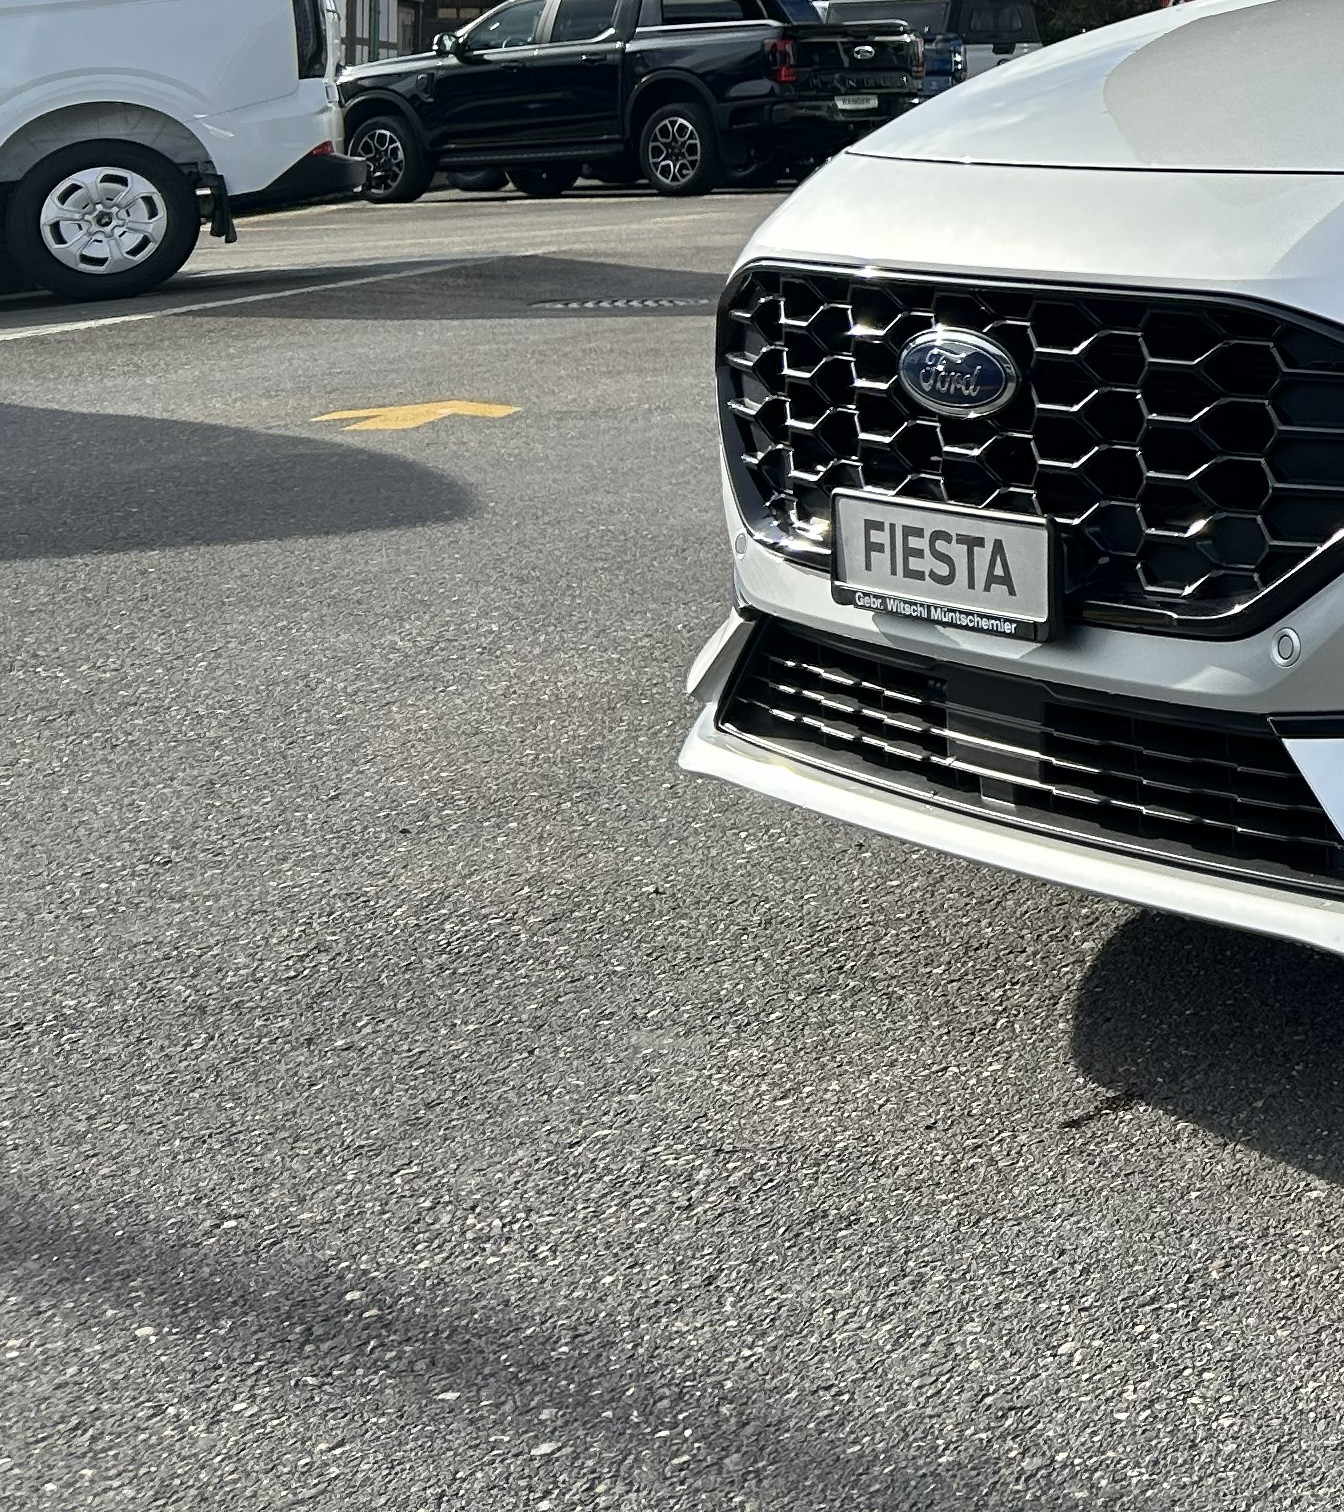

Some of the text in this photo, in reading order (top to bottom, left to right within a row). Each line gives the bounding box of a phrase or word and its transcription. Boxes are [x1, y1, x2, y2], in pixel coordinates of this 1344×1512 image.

[919, 347, 982, 397] Ford
[863, 518, 1018, 598] FIESTA
[855, 591, 1018, 635] Gebr. Witschi Müntschemier
